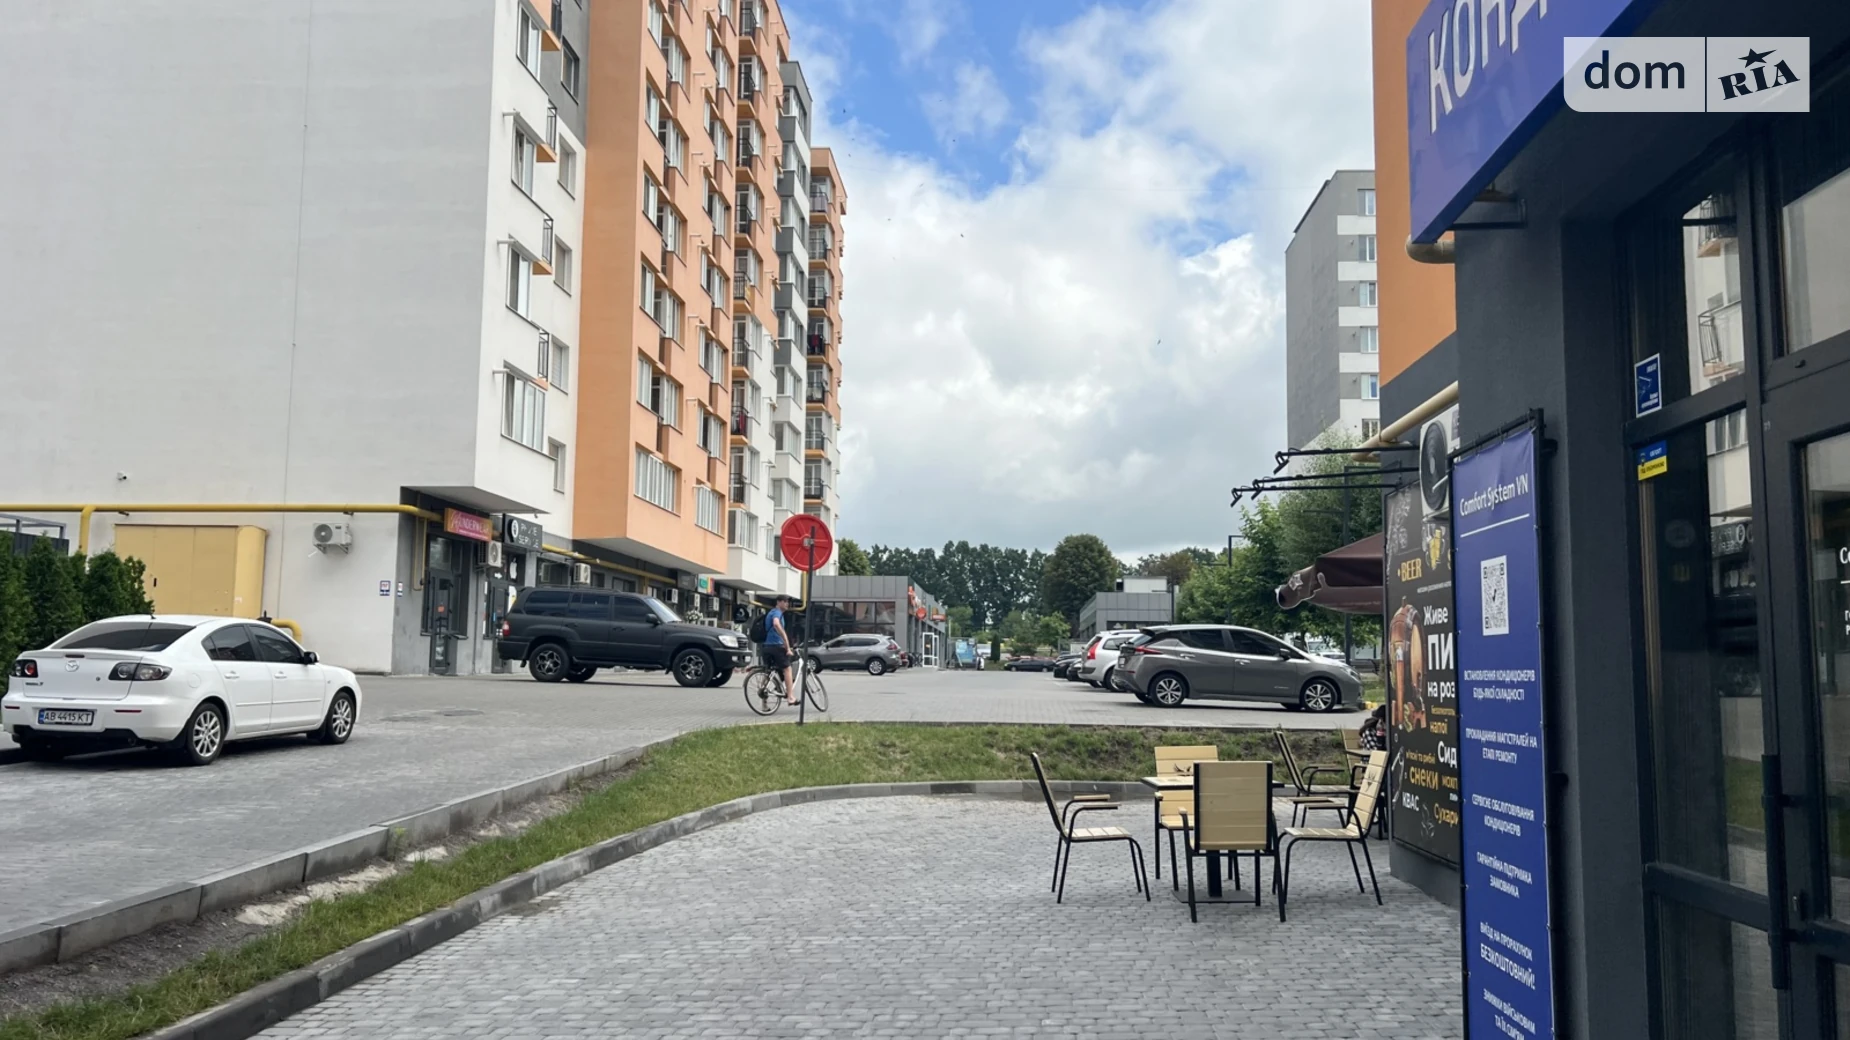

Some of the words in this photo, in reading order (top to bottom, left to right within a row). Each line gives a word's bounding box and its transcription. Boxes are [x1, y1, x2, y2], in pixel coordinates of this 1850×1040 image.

[1460, 493, 1487, 517] Comfort
[1487, 482, 1516, 511] System
[1515, 473, 1529, 496] VN
[1401, 558, 1422, 582] BEER
[1423, 605, 1448, 626] Живе
[1427, 680, 1438, 698] на
[1439, 683, 1455, 703] роз
[45, 712, 57, 721] AB
[57, 712, 76, 721] 4415
[78, 713, 91, 722] KT
[1529, 735, 1538, 748] НА
[1438, 740, 1457, 769] Сид
[1409, 766, 1438, 790] снеки
